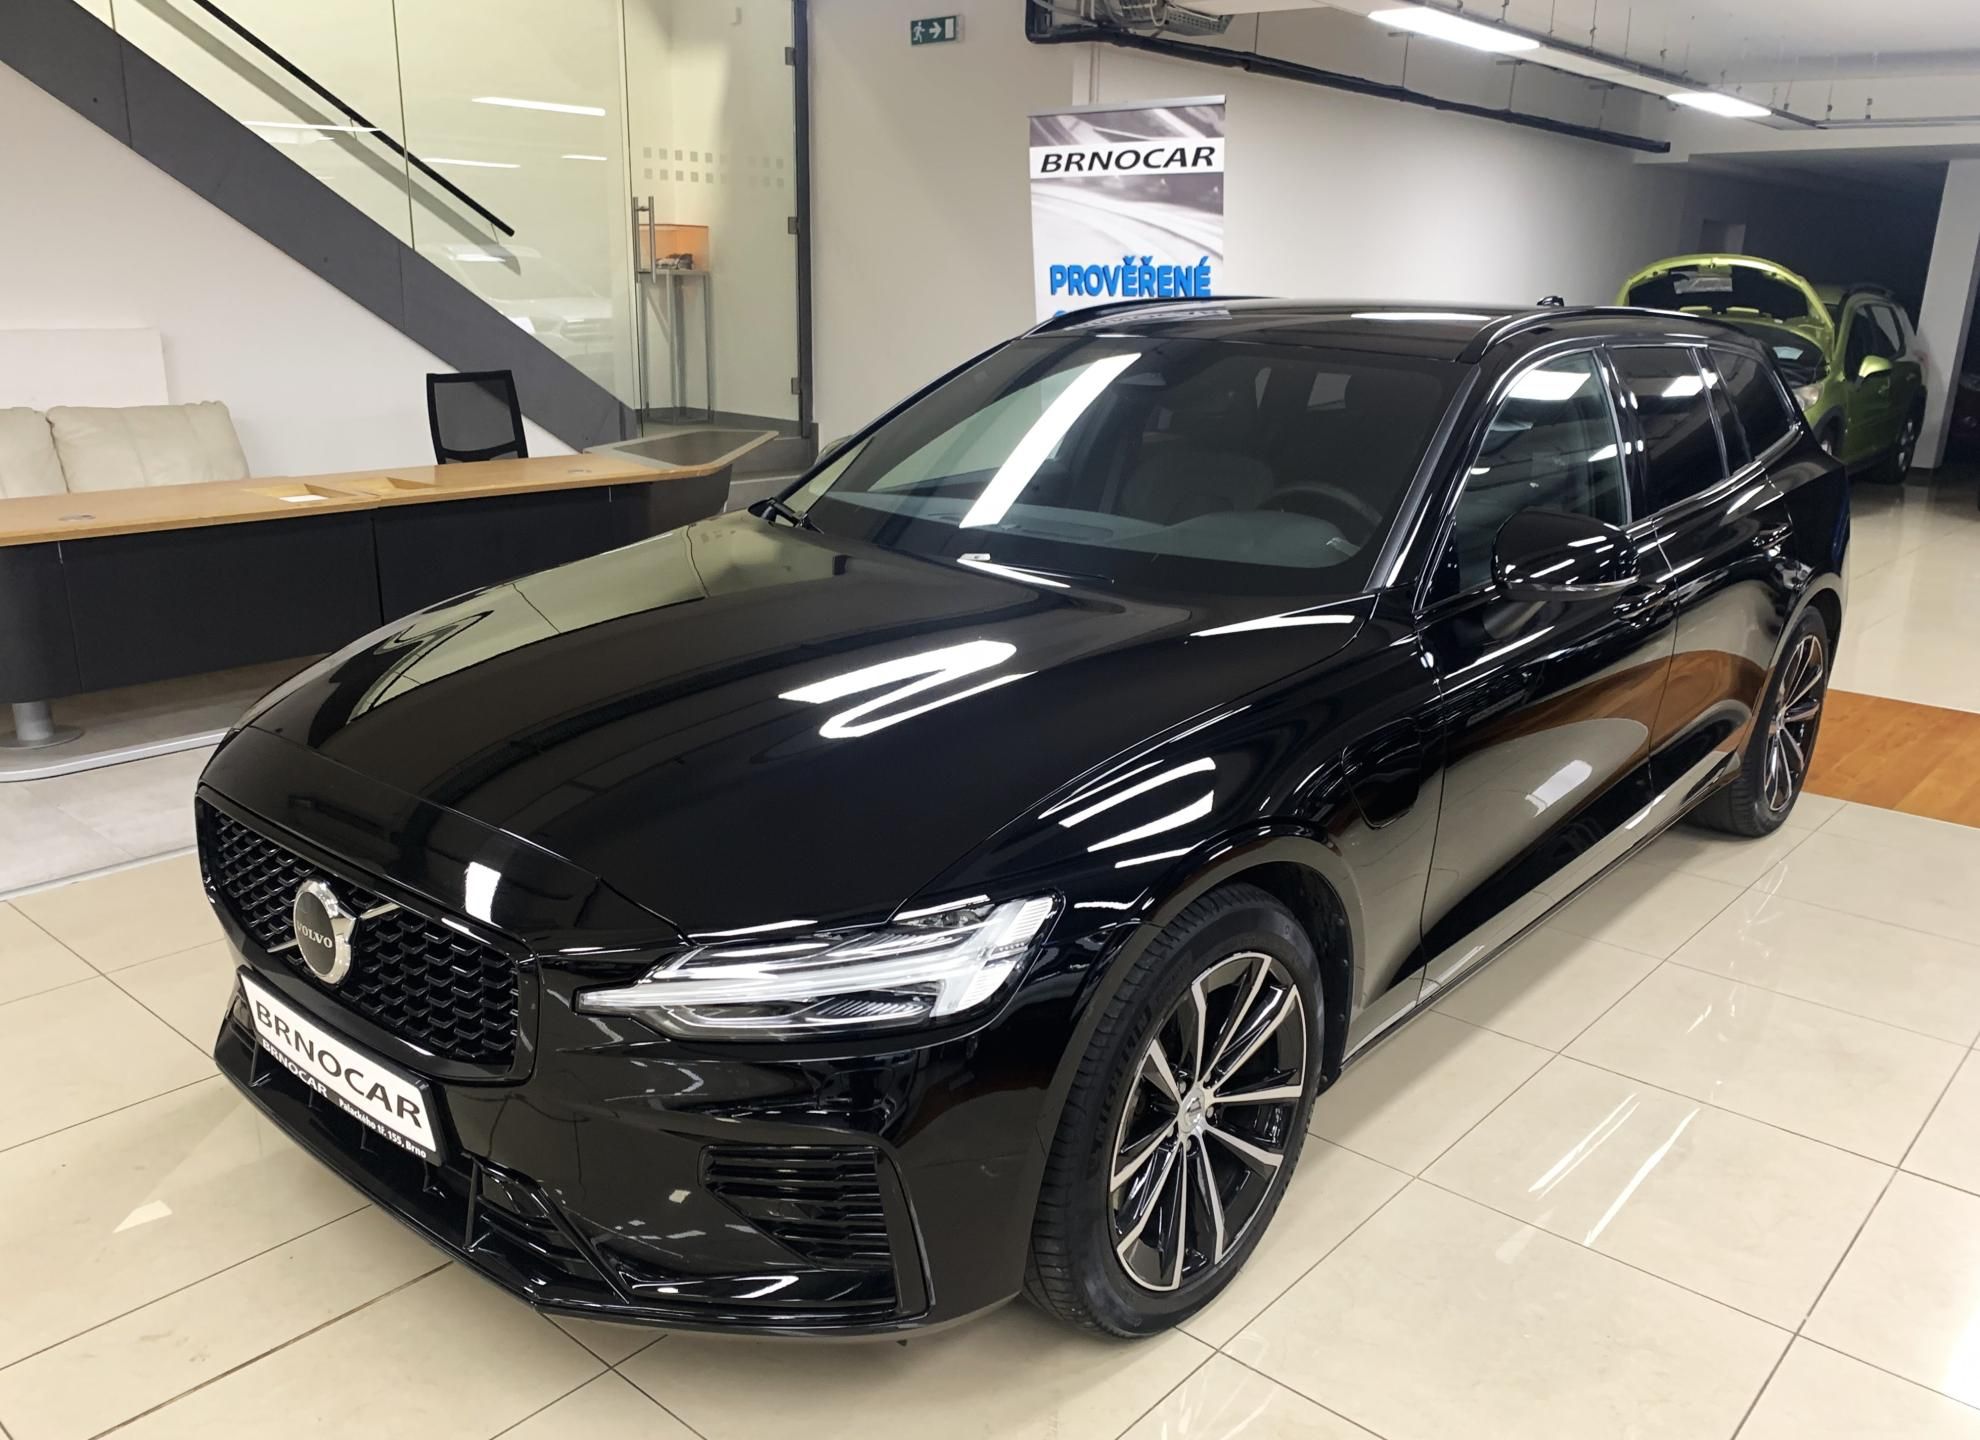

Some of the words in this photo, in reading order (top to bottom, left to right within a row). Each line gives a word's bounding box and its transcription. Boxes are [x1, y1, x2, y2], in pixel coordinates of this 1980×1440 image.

[1041, 147, 1216, 173] BRNOCAR
[1049, 256, 1211, 298] PROVĚŘENÉ
[297, 920, 333, 949] VOLVO
[256, 1000, 422, 1129] BRNOCAR
[262, 1038, 329, 1098] BRNOCAR
[405, 1140, 427, 1159] Brno
